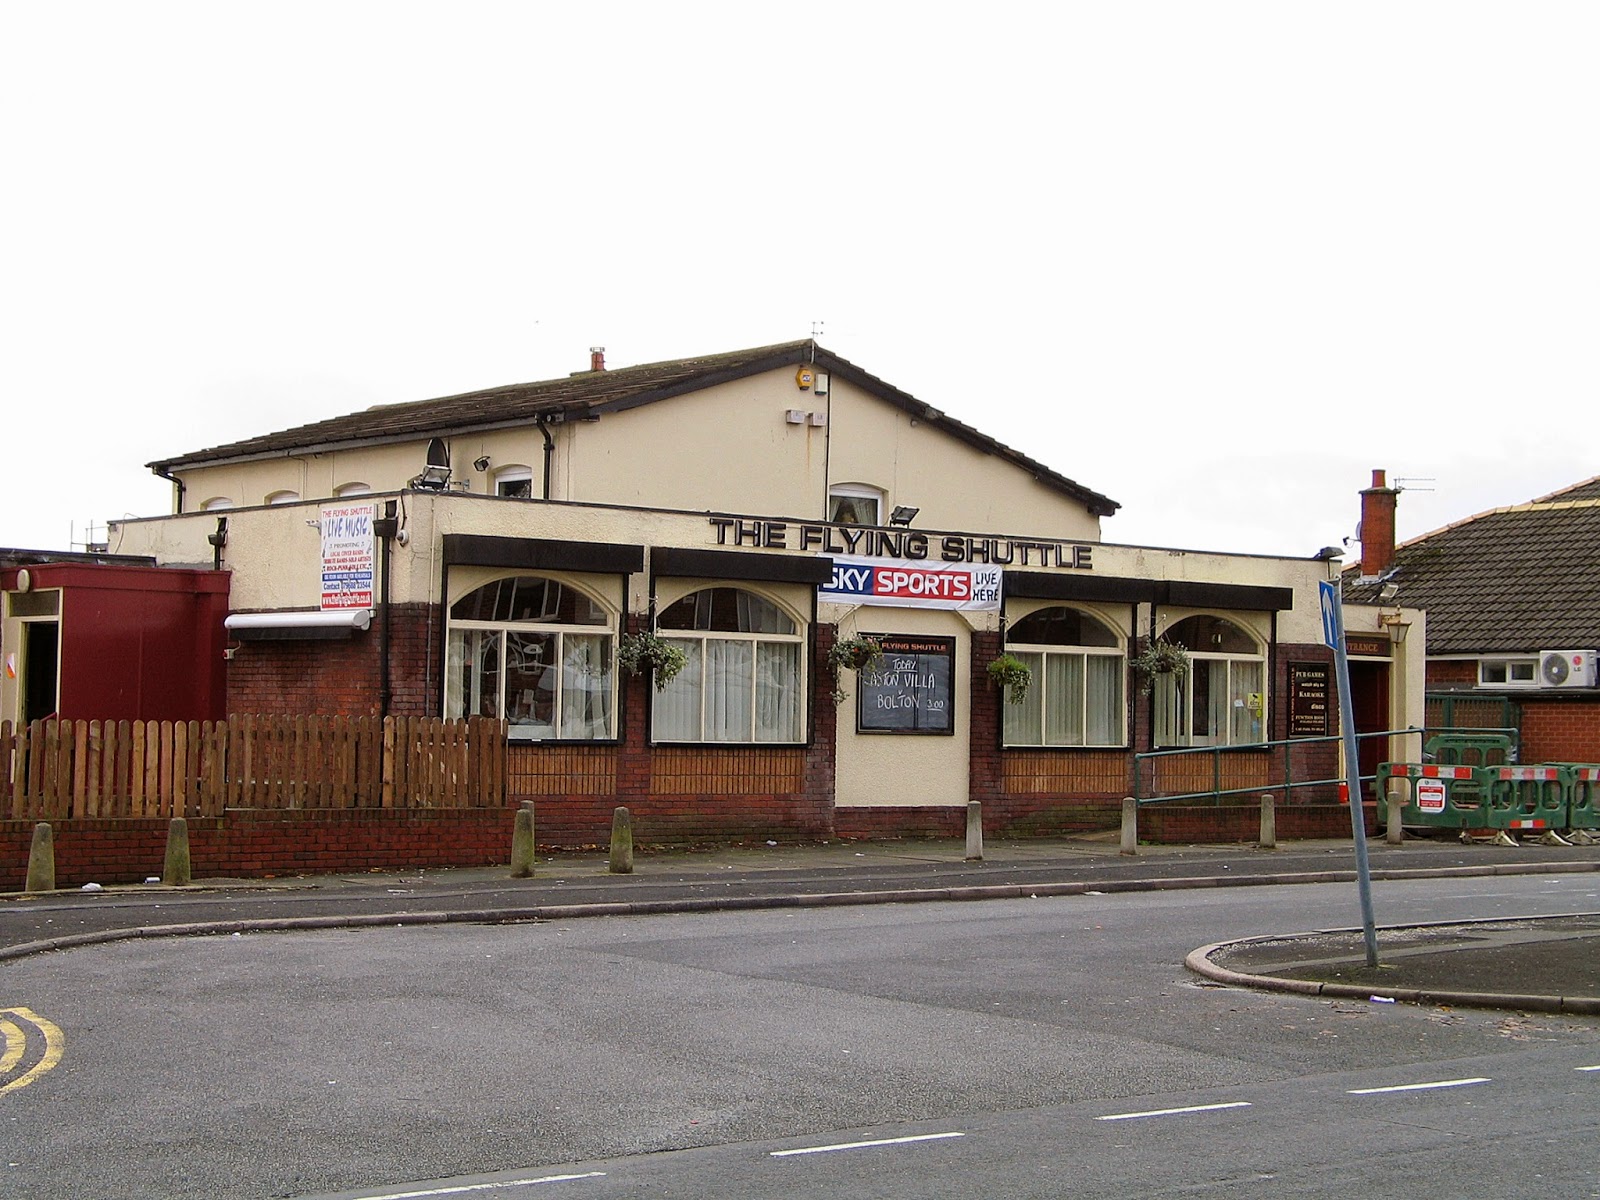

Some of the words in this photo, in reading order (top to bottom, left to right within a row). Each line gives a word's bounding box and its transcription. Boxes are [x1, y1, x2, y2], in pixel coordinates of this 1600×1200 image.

[322, 510, 332, 518] THE
[333, 509, 349, 517] FLYING
[350, 506, 372, 516] SHUTTLE
[327, 518, 343, 538] LIVE
[333, 542, 360, 550] PROMOTING
[709, 517, 787, 549] THE
[800, 525, 929, 560] FLYING
[941, 535, 1093, 570] SHUTTLE
[823, 567, 870, 591] SKY
[877, 571, 968, 597] SPORTS
[975, 572, 997, 585] LIVE
[323, 582, 340, 590] Contact
[972, 588, 998, 601] HERE
[881, 642, 909, 650] FLYING
[911, 643, 947, 651] SHUTTLE
[1347, 642, 1379, 652] TRANCE
[904, 673, 935, 689] VILLA
[877, 693, 920, 710] BOLTON
